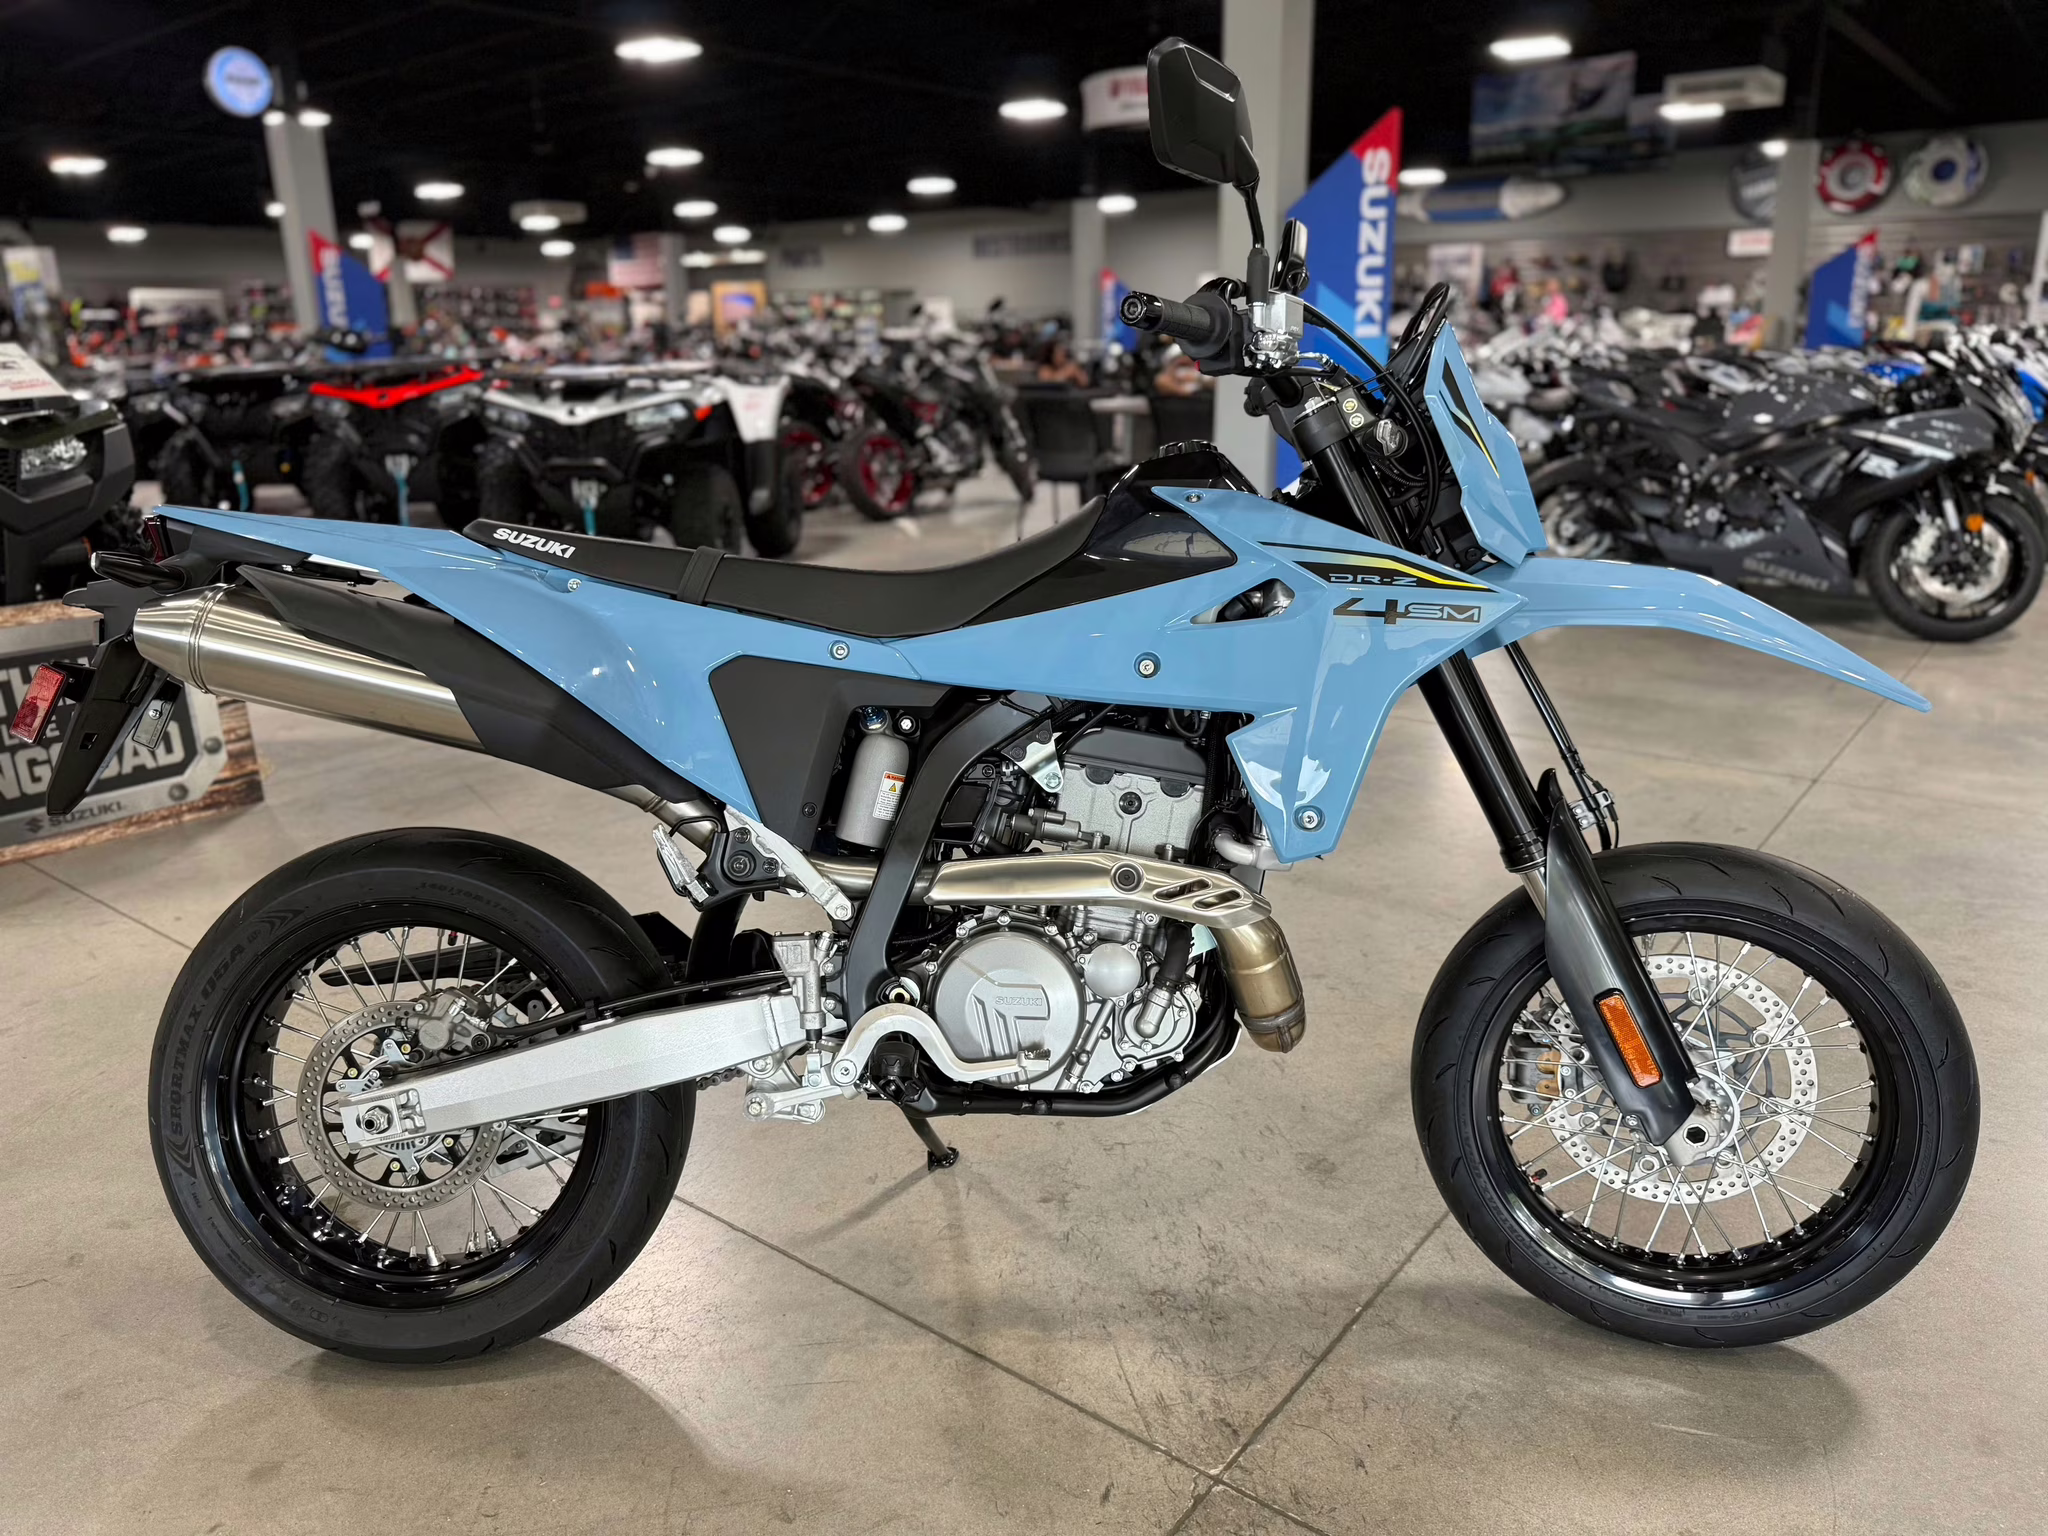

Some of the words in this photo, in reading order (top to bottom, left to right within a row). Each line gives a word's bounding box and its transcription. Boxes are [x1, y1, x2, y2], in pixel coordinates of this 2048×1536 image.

[1353, 147, 1392, 338] SUZUKI
[493, 527, 577, 559] SUZUKI
[1328, 573, 1418, 586] DR-Z
[48, 800, 123, 828] SUZUKI
[995, 996, 1043, 1006] SUZUKI
